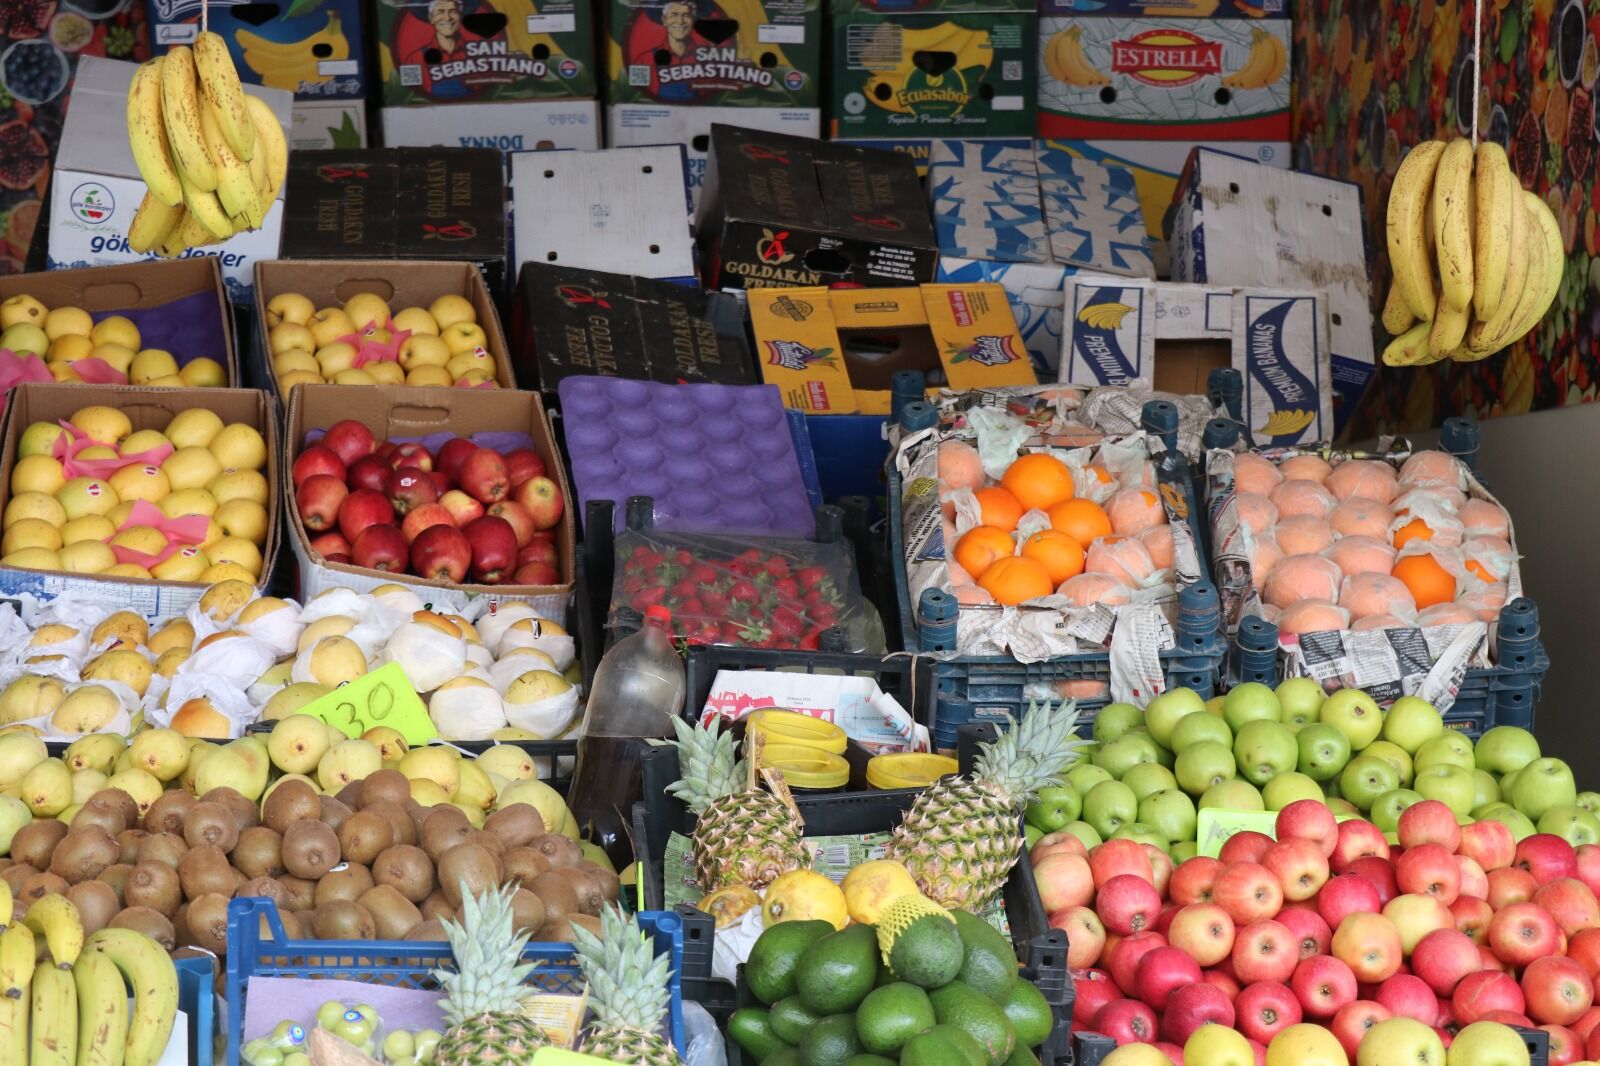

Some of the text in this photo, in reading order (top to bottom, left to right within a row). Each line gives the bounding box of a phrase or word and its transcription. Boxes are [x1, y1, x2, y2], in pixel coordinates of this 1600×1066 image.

[466, 41, 506, 57] SAN
[695, 47, 736, 62] SAN
[1116, 47, 1217, 68] ESTRELLA
[430, 57, 546, 81] SEBASTIANO
[658, 64, 772, 86] SEBASTIANO
[897, 87, 970, 108] Ecuasabor
[887, 113, 917, 127] Tropical
[459, 135, 524, 150] DONNA
[725, 261, 821, 285] GOLDAKAN
[565, 324, 592, 368] FRESH
[588, 314, 619, 376] GOLDAKA
[1083, 335, 1127, 377] PREMIUM
[1252, 323, 1307, 403] PREMIUM BANANAS
